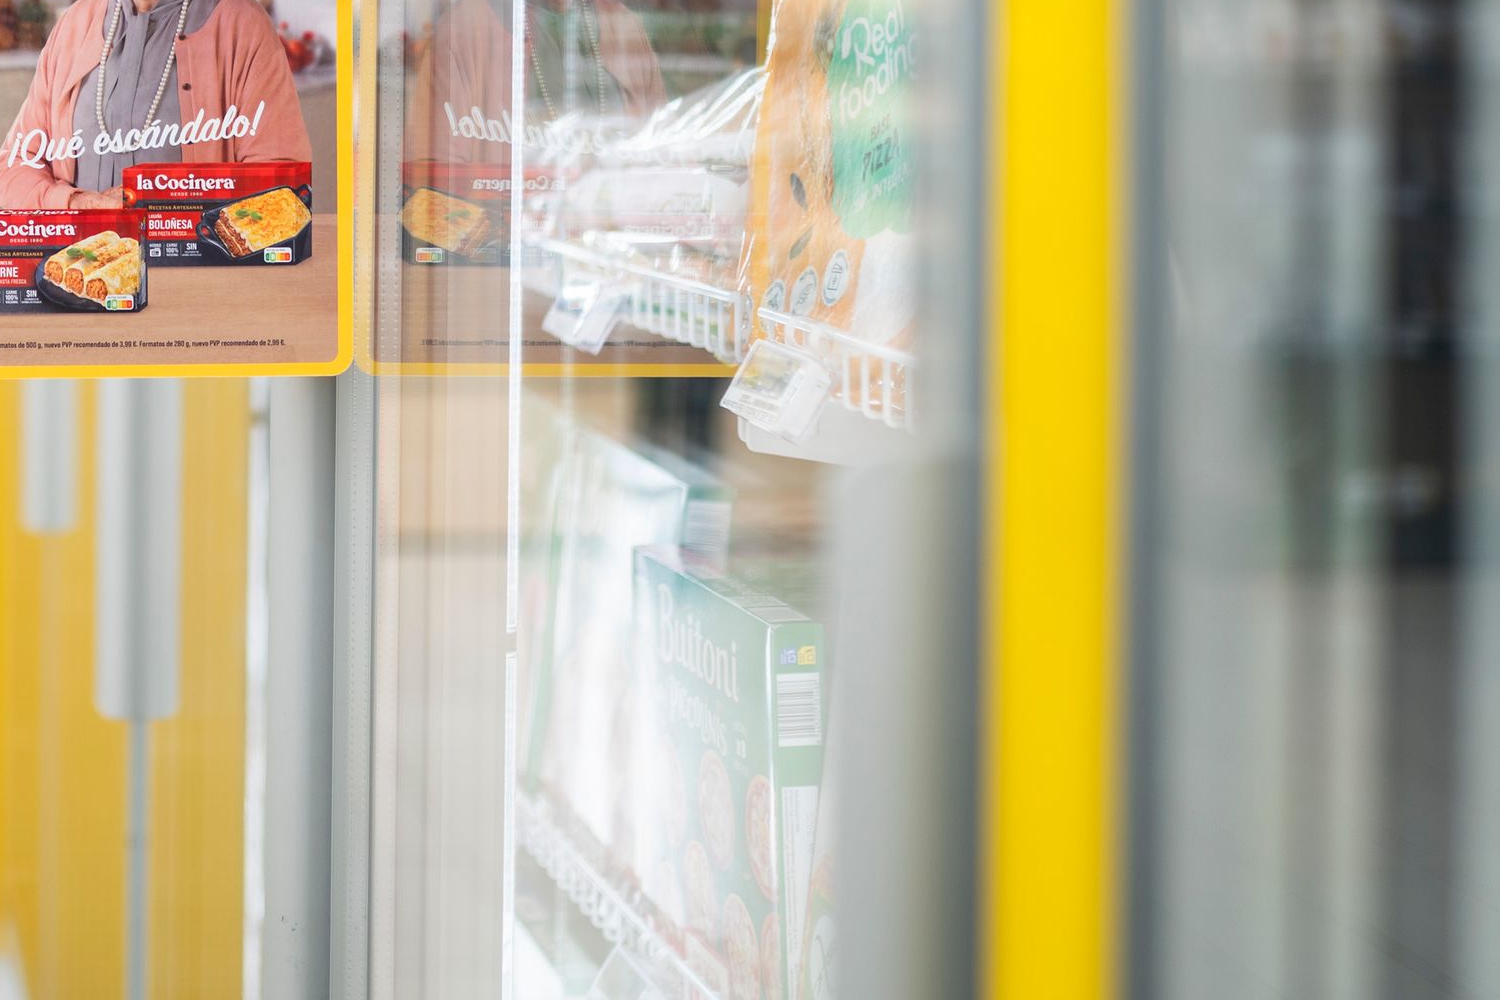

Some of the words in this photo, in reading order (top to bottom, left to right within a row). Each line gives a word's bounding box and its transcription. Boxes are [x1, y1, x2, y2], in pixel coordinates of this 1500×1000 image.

[6, 128, 86, 169] ¡Qué
[93, 100, 266, 155] escándalo!
[136, 174, 154, 190] la
[155, 174, 235, 191] Cocinera
[148, 217, 193, 230] BOLOÑESA
[186, 242, 197, 250] SIN
[26, 290, 38, 298] SIN
[221, 339, 259, 347] recomendado
[657, 583, 740, 702] Buitoni
